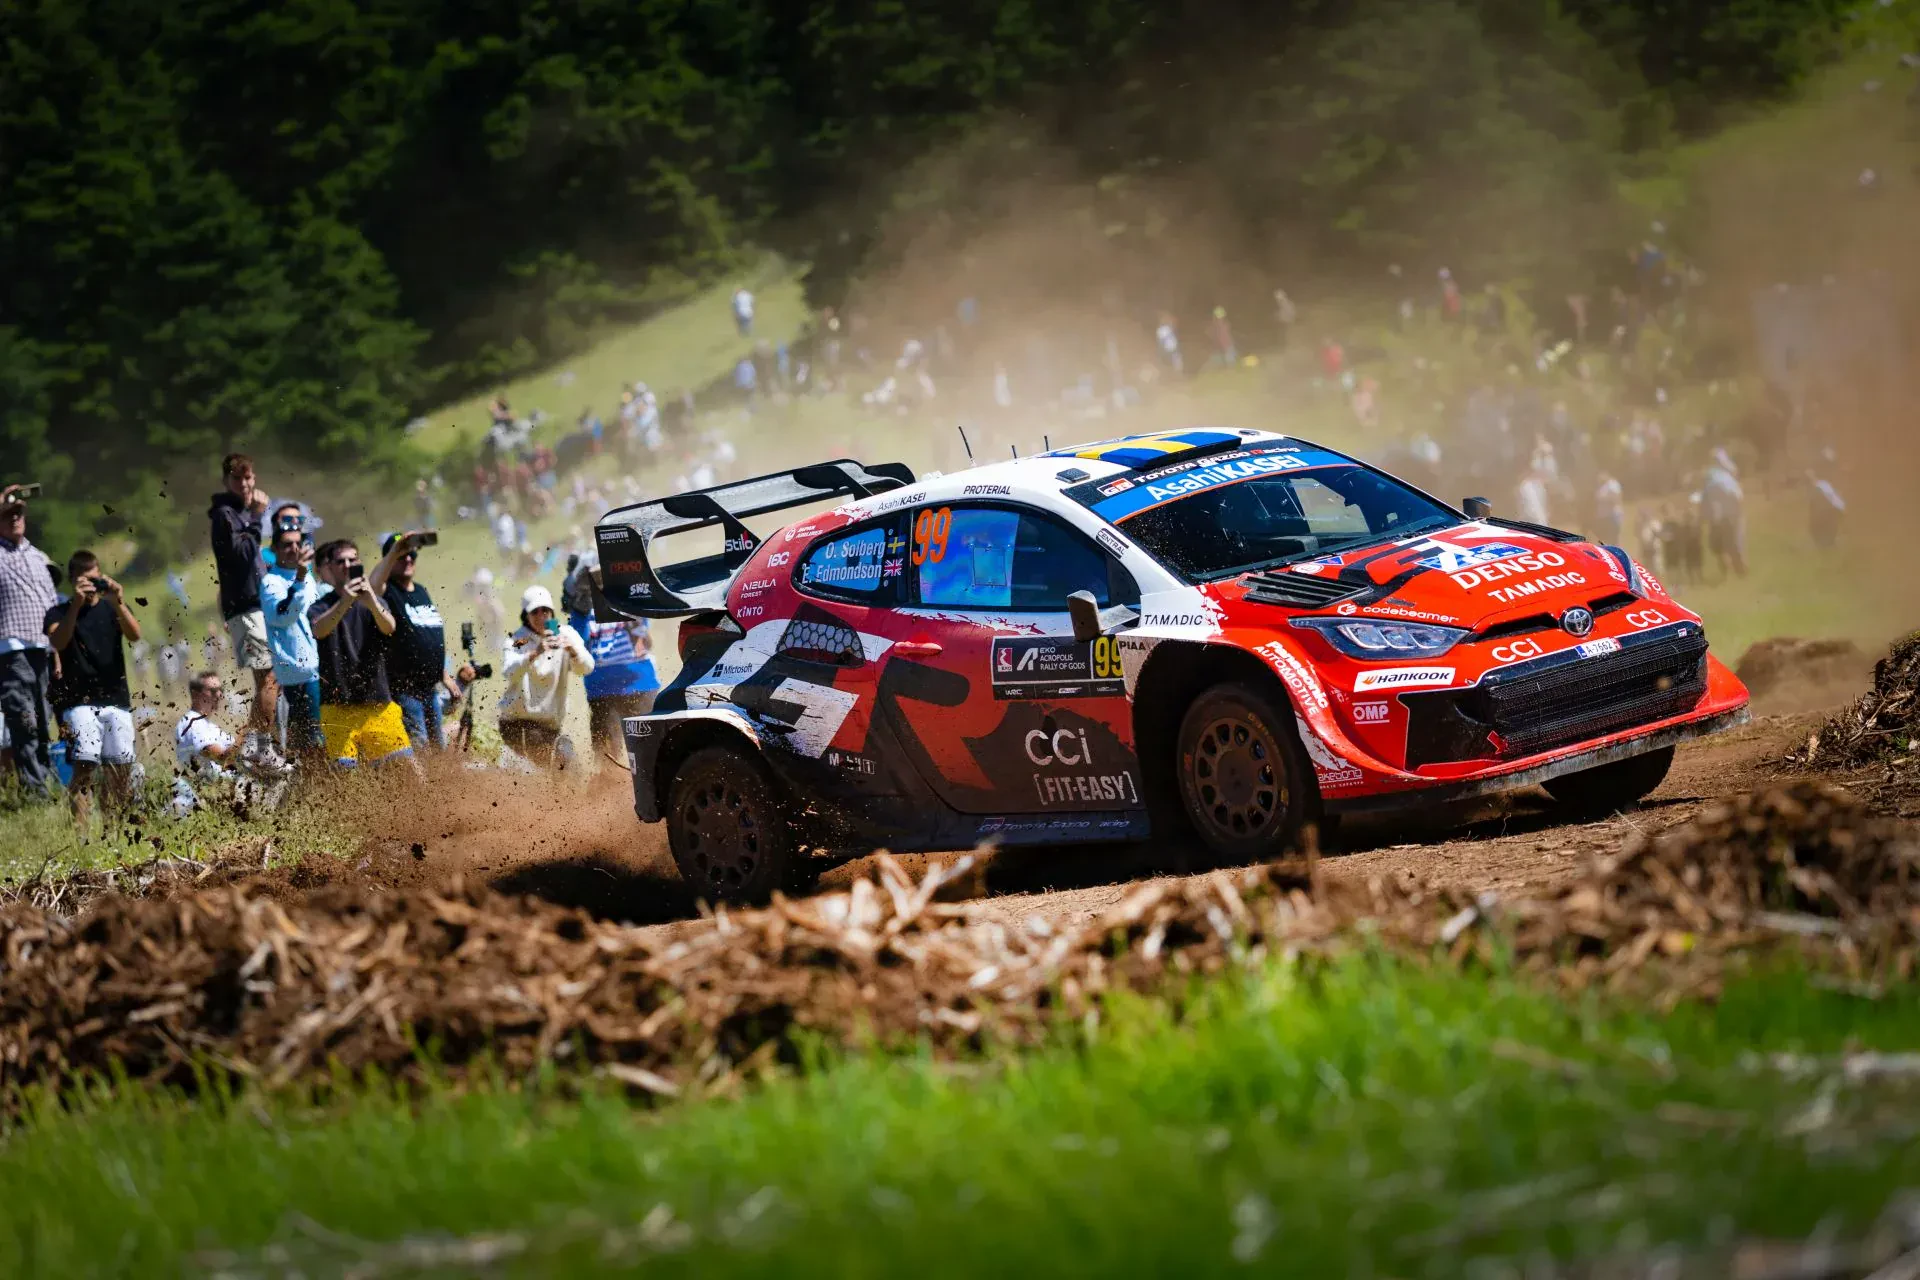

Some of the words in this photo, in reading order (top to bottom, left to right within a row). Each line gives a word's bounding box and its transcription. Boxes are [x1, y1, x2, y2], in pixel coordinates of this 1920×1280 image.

[1133, 462, 1197, 483] TOYOTA
[1146, 454, 1309, 501] AsahiKASEI
[963, 485, 1011, 495] PROTERIAL
[877, 492, 927, 511] AsahiKASEI
[912, 507, 952, 566] 99
[1097, 530, 1125, 555] CENTRAL
[825, 542, 837, 559] O.
[841, 541, 886, 559] Solberg
[802, 566, 813, 584] E.
[816, 562, 882, 583] Edmondson
[1449, 552, 1565, 589] DENSO
[740, 590, 762, 599] FOREST
[1487, 572, 1586, 603] TAMADIC
[737, 606, 763, 618] KINTO
[1144, 614, 1204, 625] TAMADIC
[1363, 606, 1457, 623] codebeamer
[1119, 640, 1146, 651] PIAA
[1040, 654, 1074, 662] ACROPOLIS
[1059, 662, 1068, 670] OF
[1068, 662, 1085, 670] GODS
[1095, 636, 1123, 678] 99
[723, 662, 753, 674] Microsoft
[1265, 641, 1329, 708] Panasonic
[1252, 646, 1320, 715] AUTOMOTIVE
[1353, 704, 1389, 720] OMP
[626, 720, 652, 734] ENDLESS
